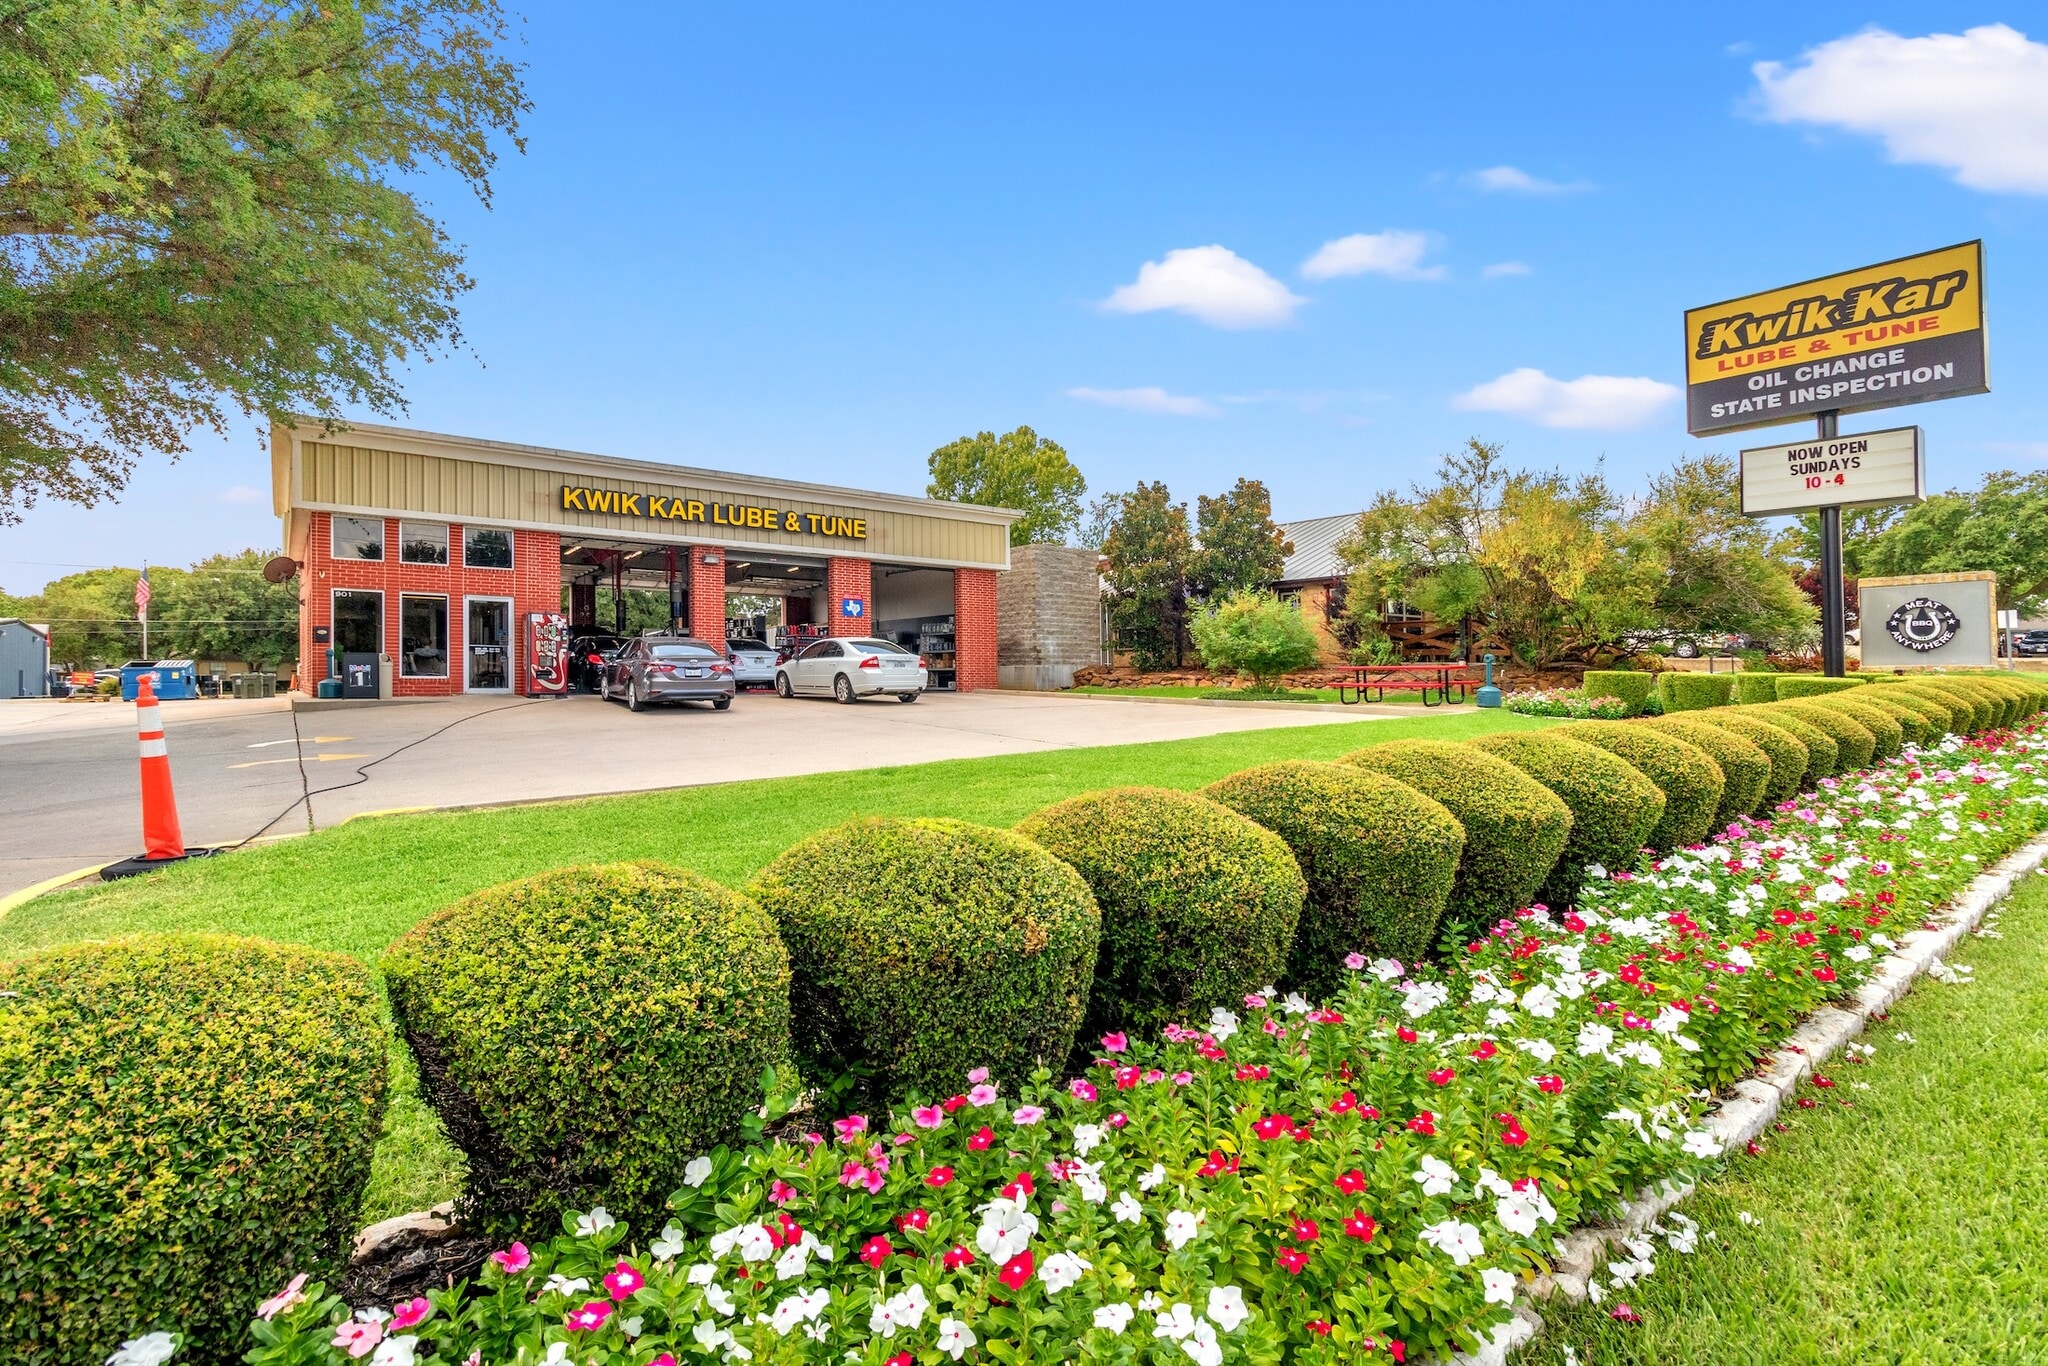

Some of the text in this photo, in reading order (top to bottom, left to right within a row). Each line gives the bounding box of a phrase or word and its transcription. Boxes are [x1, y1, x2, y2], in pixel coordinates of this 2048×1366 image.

[1698, 274, 1964, 357] Kwik Kar
[1718, 316, 1940, 372] LUBE & TUNE
[1748, 348, 1905, 391] OIL CHANGE
[1711, 362, 1954, 418] STATE INSPECTION
[1787, 439, 1868, 462] NOW OPEN
[1790, 456, 1861, 475] SUNDAYS
[562, 486, 867, 539] KWIK KAR LUBE & TUNE
[1904, 600, 1941, 611] MEAT
[1891, 630, 1954, 650] ANYWHERE
[355, 671, 364, 686] 1
